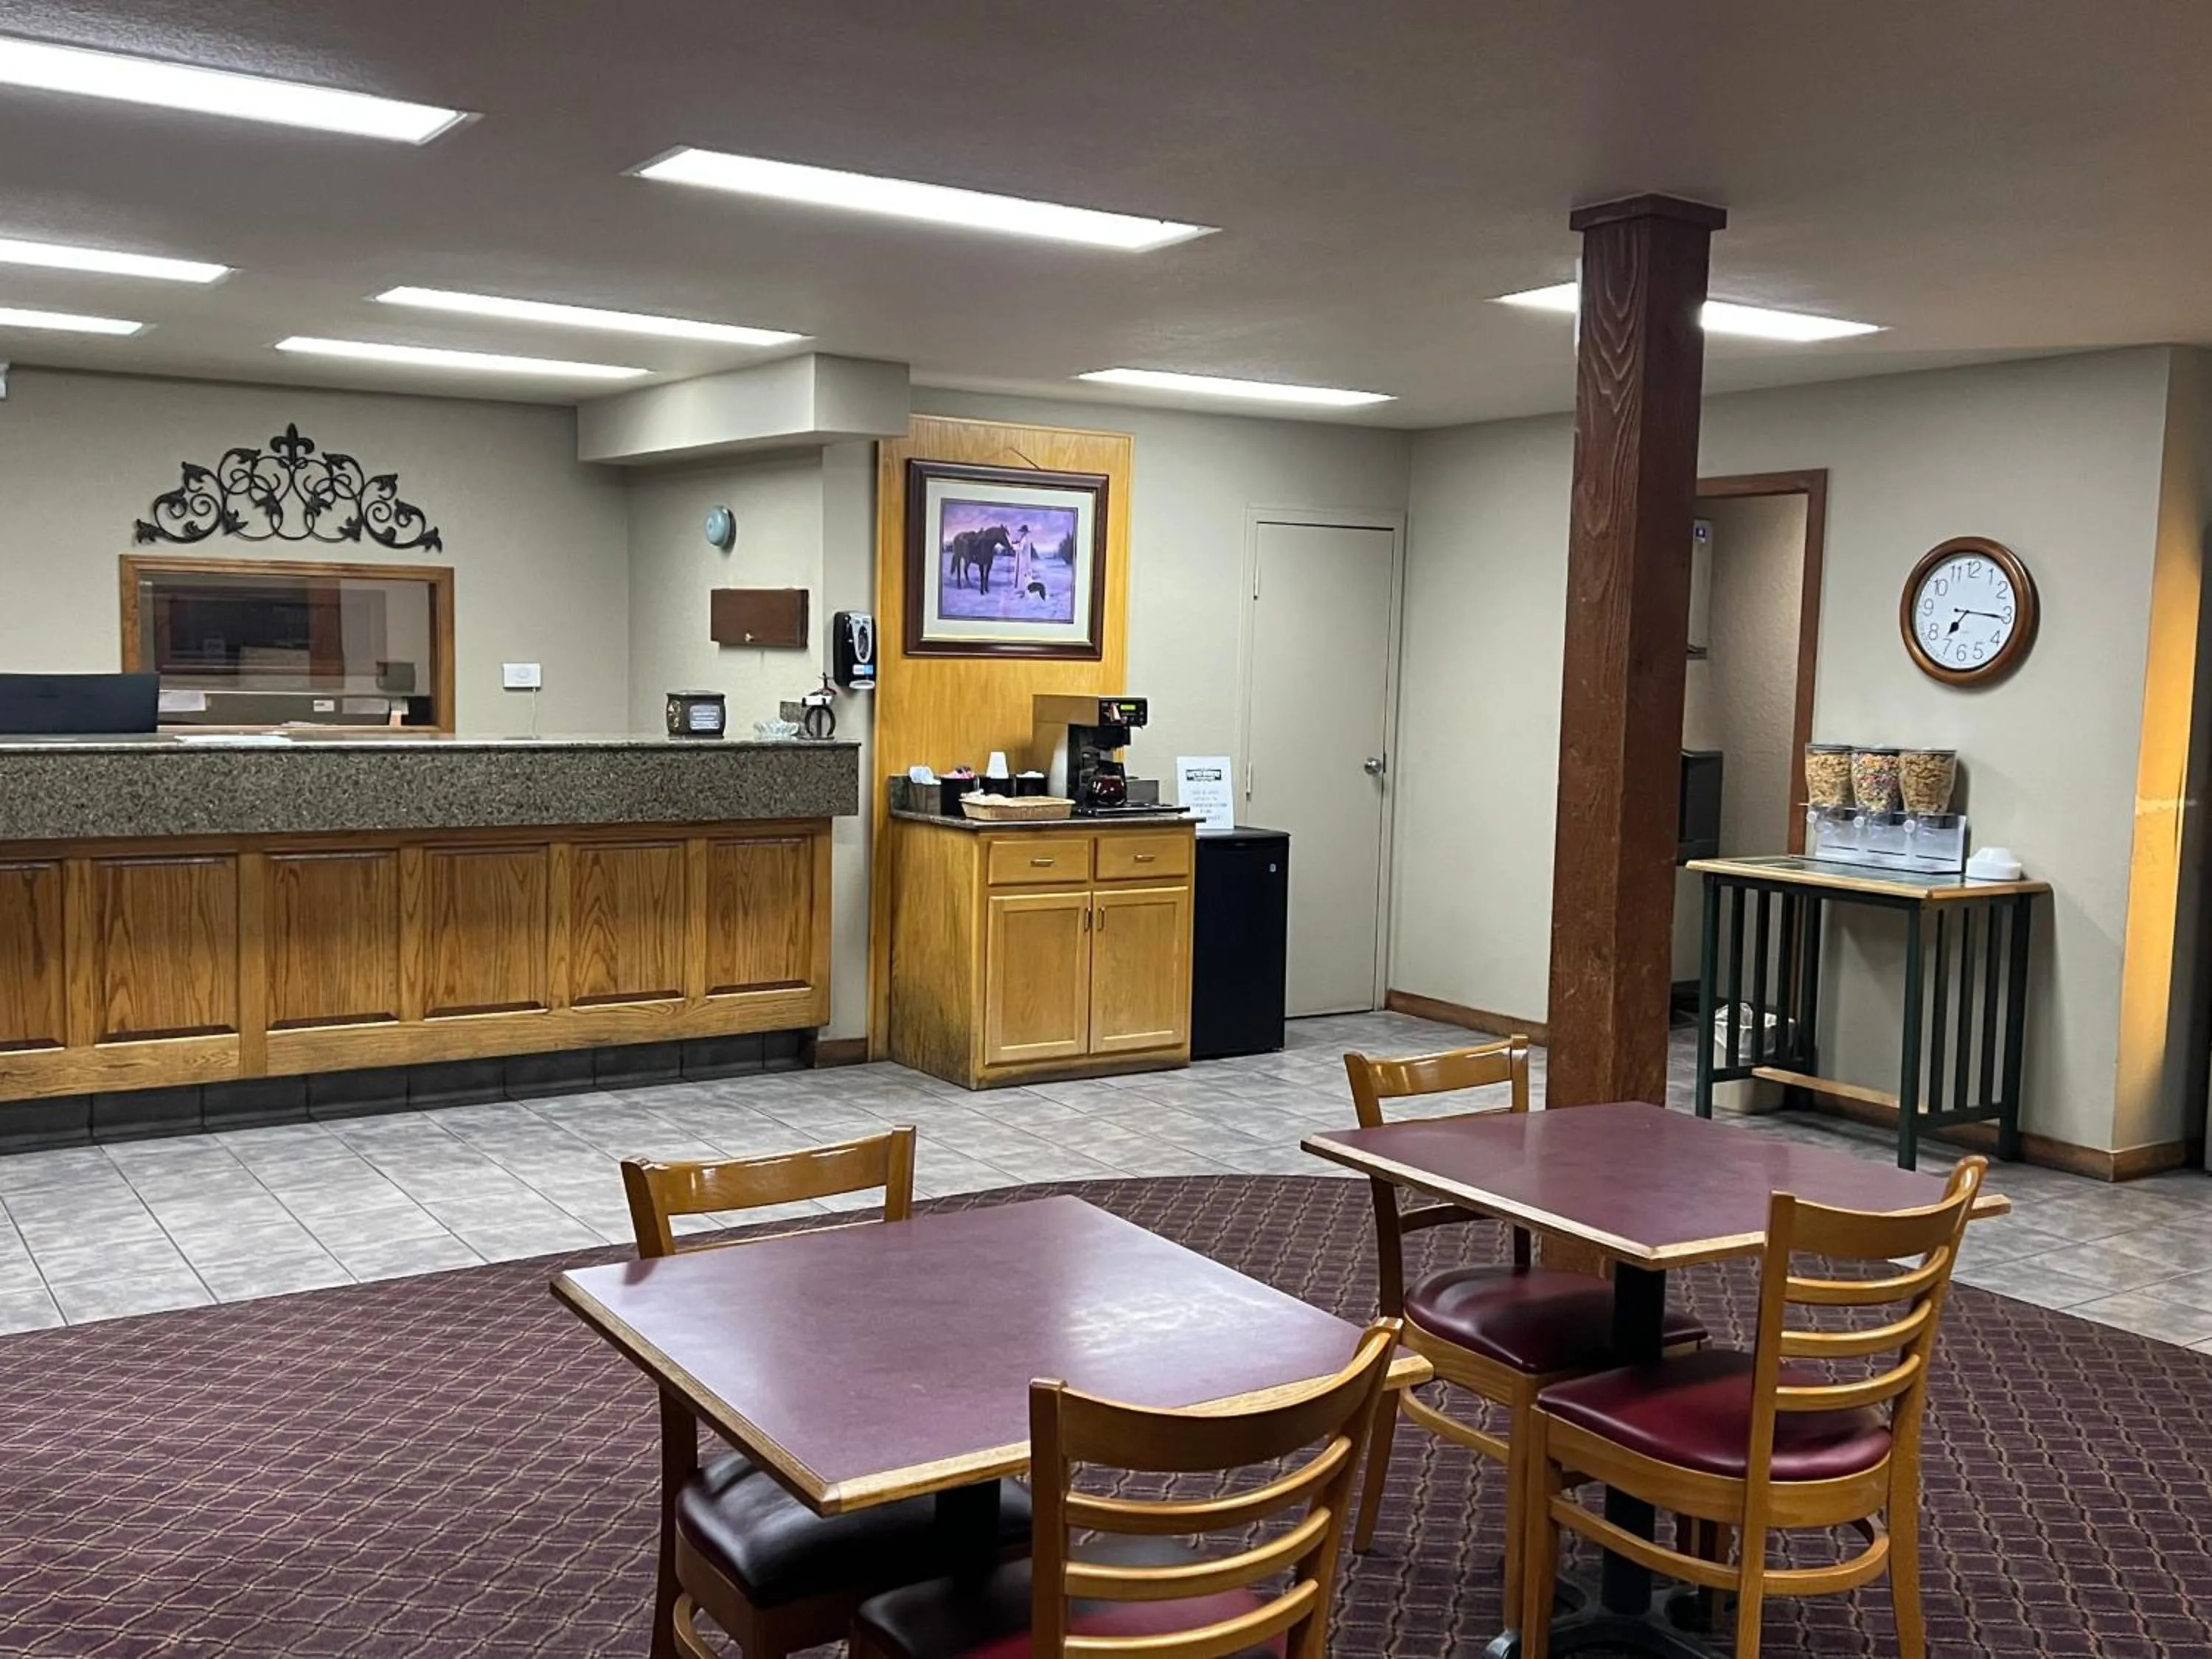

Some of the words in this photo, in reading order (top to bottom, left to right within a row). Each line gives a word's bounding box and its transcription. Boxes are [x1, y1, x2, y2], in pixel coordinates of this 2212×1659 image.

[1951, 565, 1961, 582] 11
[1966, 560, 1982, 579] 12
[1989, 568, 1994, 585] 1
[1935, 578, 1948, 596] 10
[1996, 581, 2008, 599] 2
[1923, 599, 1934, 616] 9
[2003, 606, 2012, 624] 3
[1928, 623, 1938, 640] 8
[1990, 630, 2000, 645] 4
[1943, 639, 1952, 655] 7
[1956, 644, 1966, 661] 6
[1972, 642, 1983, 660] 5
